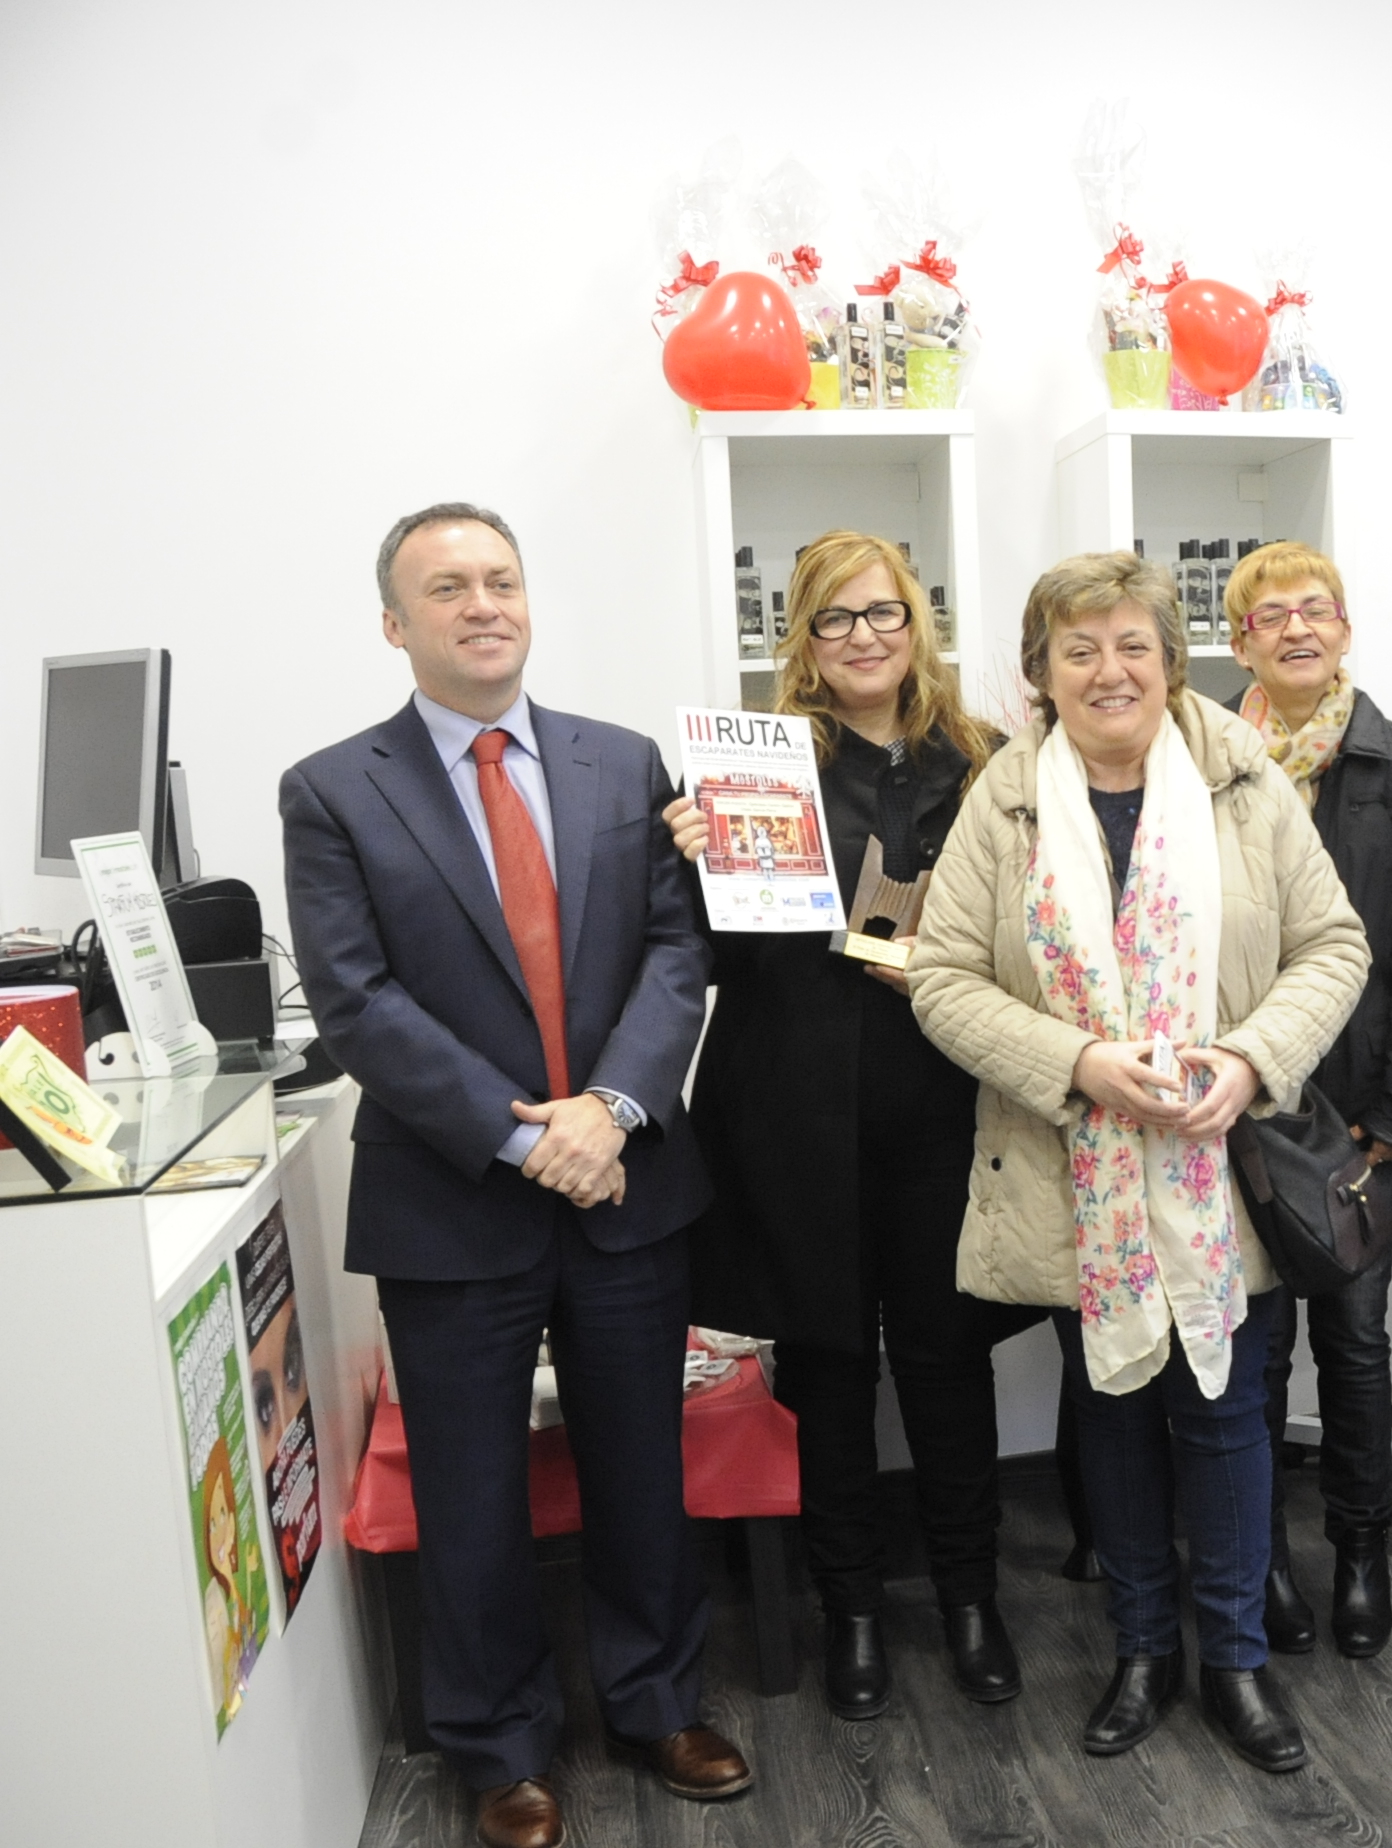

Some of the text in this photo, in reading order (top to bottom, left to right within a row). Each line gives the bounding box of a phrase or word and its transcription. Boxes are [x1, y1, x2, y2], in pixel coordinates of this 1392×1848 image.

[715, 716, 791, 749] RUTA
[795, 741, 807, 750] DE
[689, 745, 809, 762] ESCAPARATES NAVIDEÑOS
